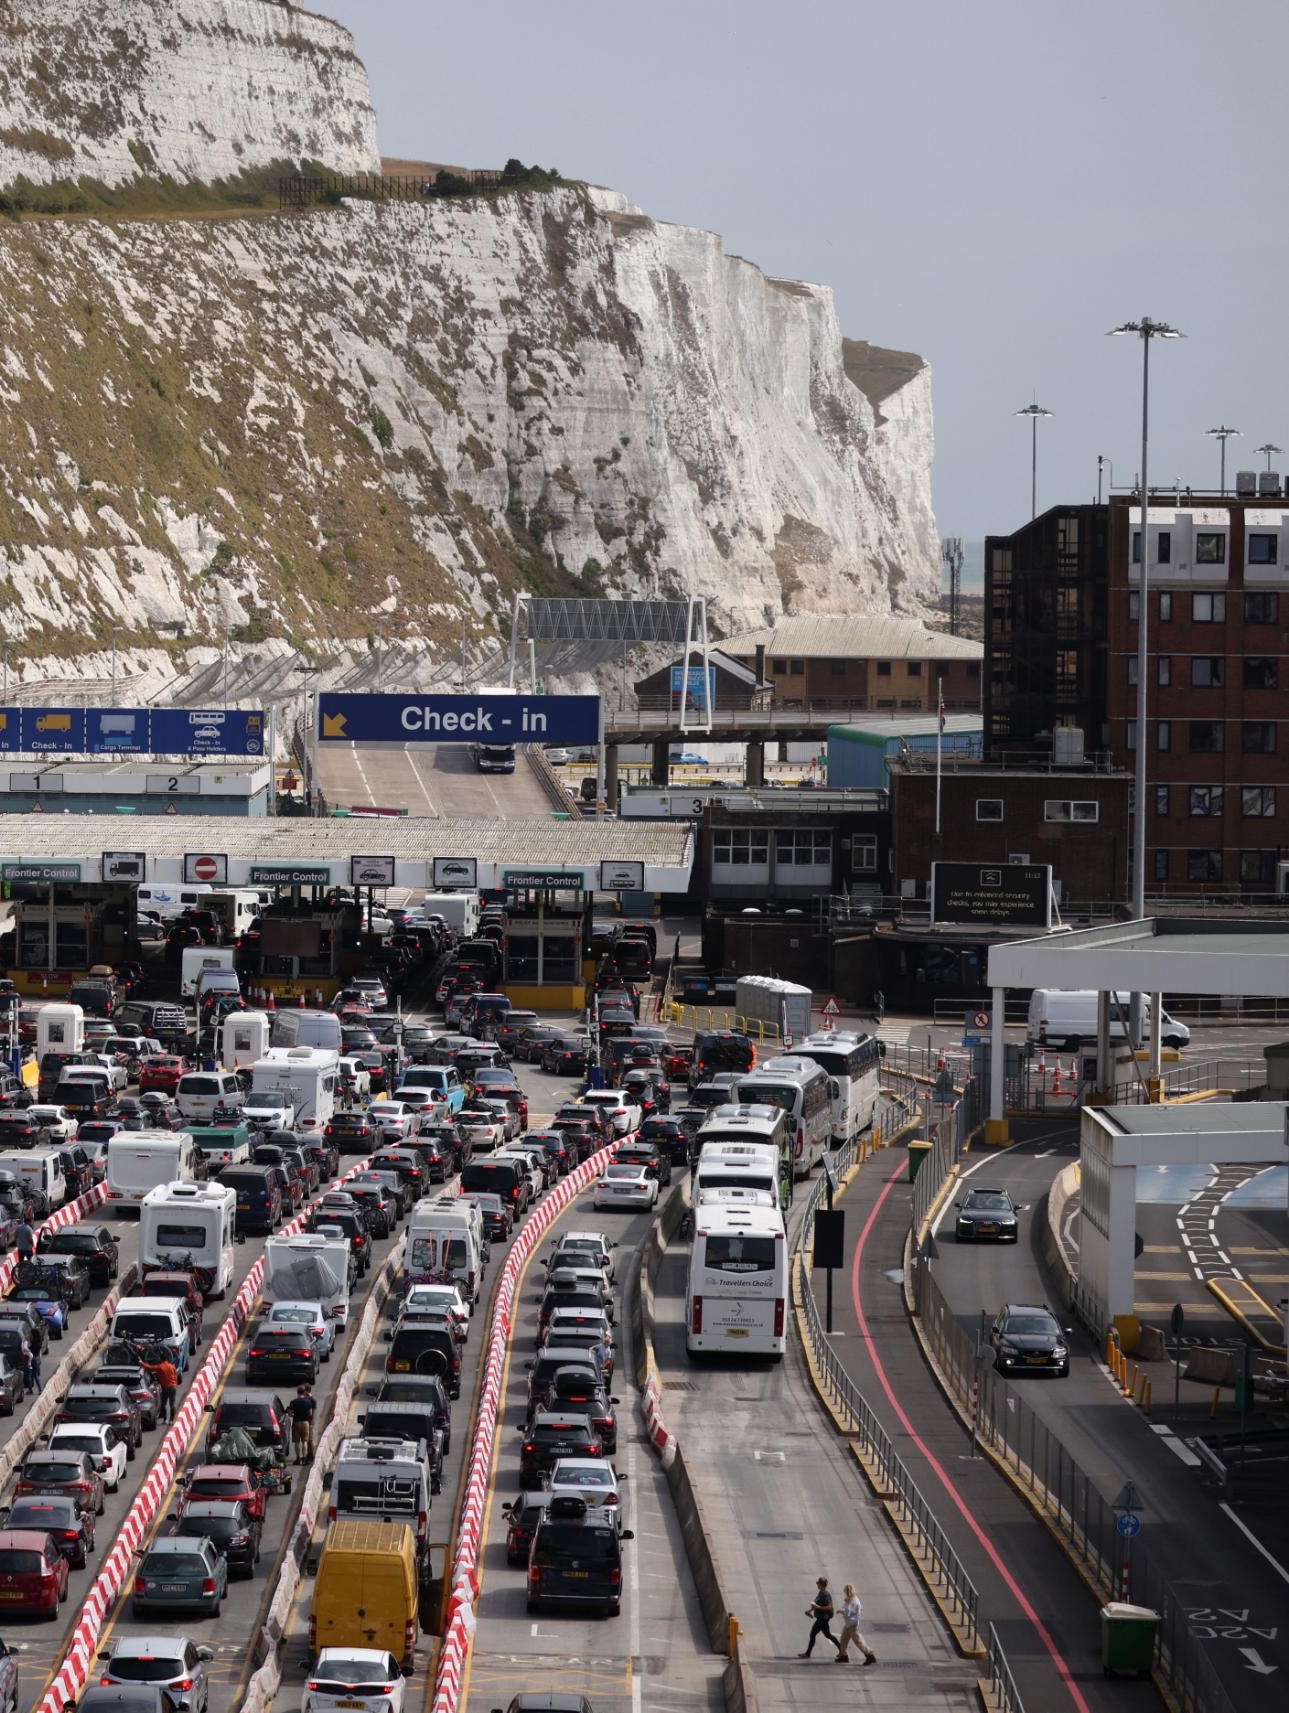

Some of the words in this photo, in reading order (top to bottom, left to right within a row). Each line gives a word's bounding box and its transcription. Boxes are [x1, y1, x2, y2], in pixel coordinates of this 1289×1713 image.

[401, 706, 492, 731] Check
[521, 708, 547, 731] in
[1, 741, 9, 749] In
[31, 741, 56, 750] Check
[64, 742, 72, 750] In
[33, 776, 40, 789] 1
[168, 777, 178, 791] 2
[692, 799, 703, 814] 3
[5, 869, 41, 878] Frontier
[43, 869, 77, 878] Control
[254, 871, 290, 881] Frontier
[292, 871, 327, 881] Control
[508, 876, 544, 885] Frontier
[546, 877, 580, 886] Control
[752, 1279, 774, 1287] Choice
[1182, 1607, 1250, 1622] A2
[1190, 1625, 1278, 1641] A20
